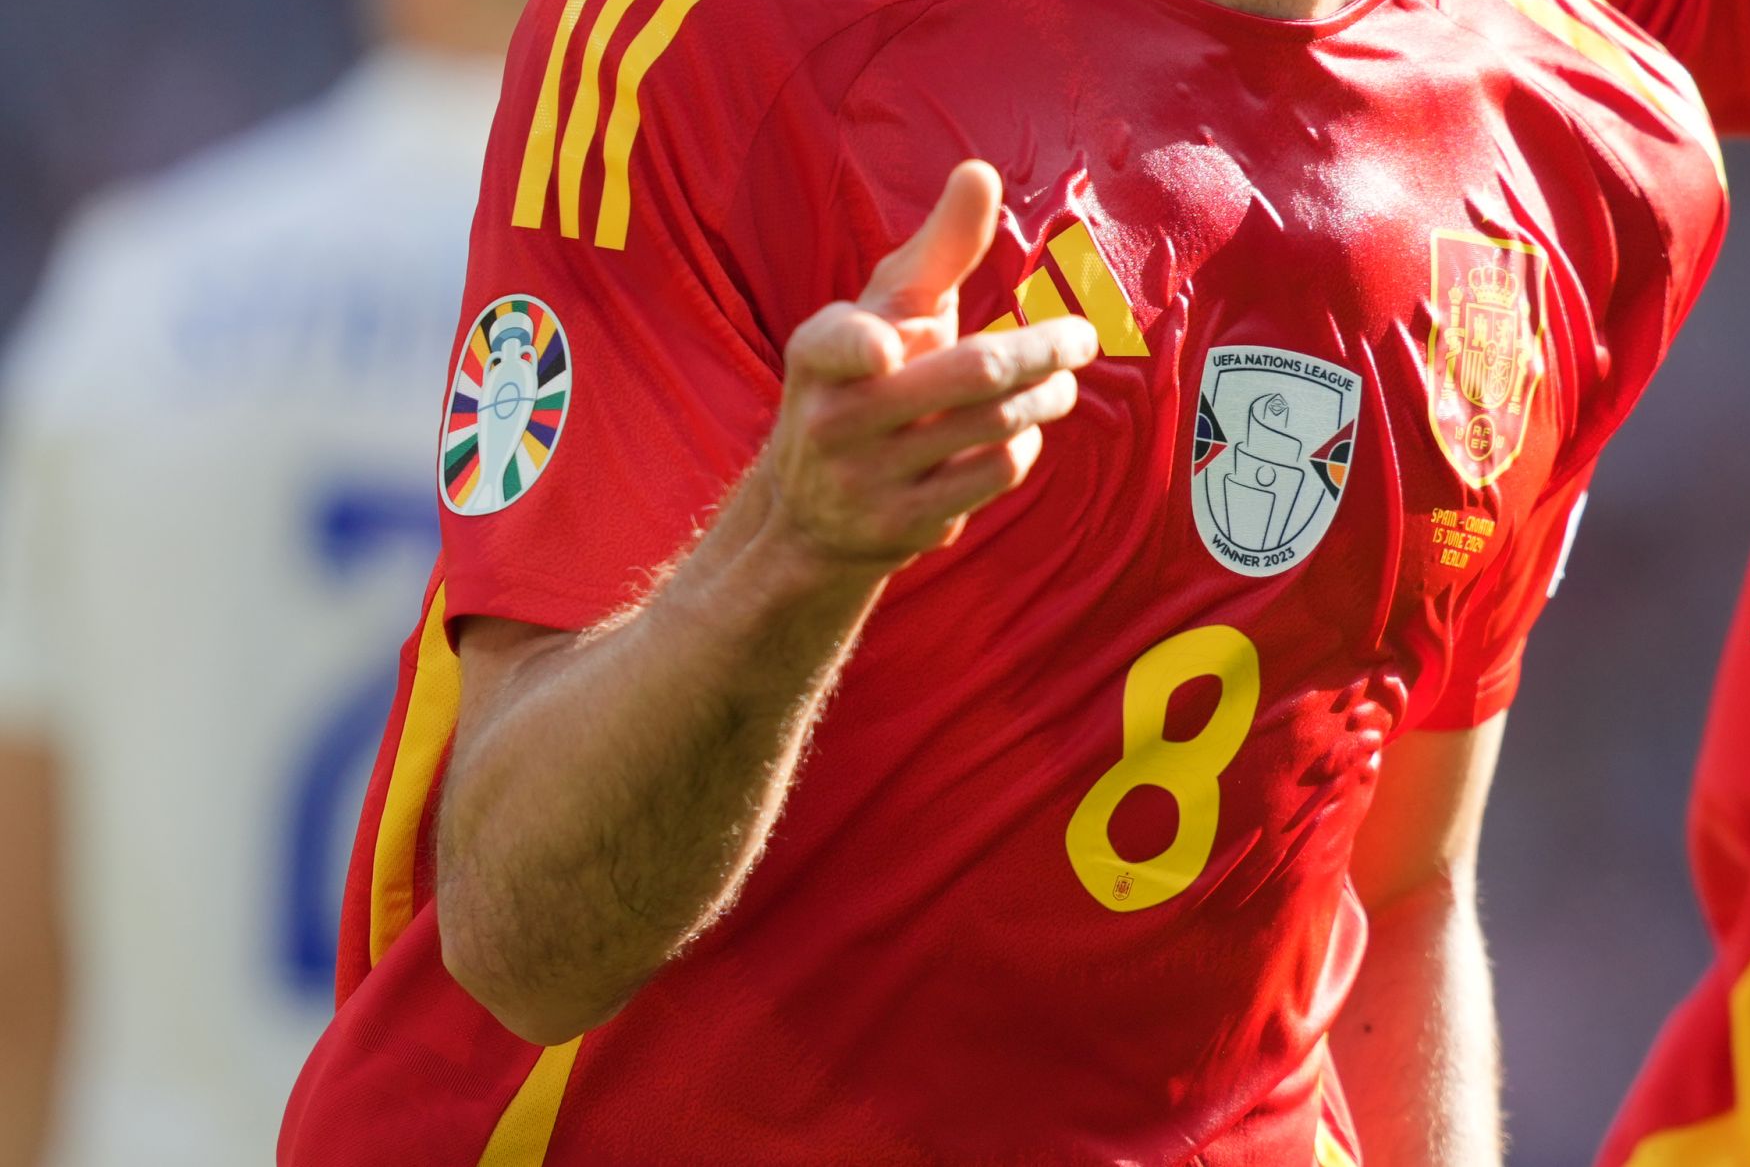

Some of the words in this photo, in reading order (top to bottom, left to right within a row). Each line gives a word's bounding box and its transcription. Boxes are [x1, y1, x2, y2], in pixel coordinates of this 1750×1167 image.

[1213, 353, 1241, 367] UEFA
[1244, 353, 1302, 372] NATIONS
[1304, 363, 1354, 392] LEAGUE
[1431, 508, 1457, 528] SPAIN
[1212, 533, 1260, 567] WINNER
[1263, 546, 1296, 567] 2023
[1433, 527, 1444, 543] 15
[1444, 529, 1465, 548] JUNE
[1440, 549, 1469, 569] BERLIN
[1065, 624, 1261, 913] 8
